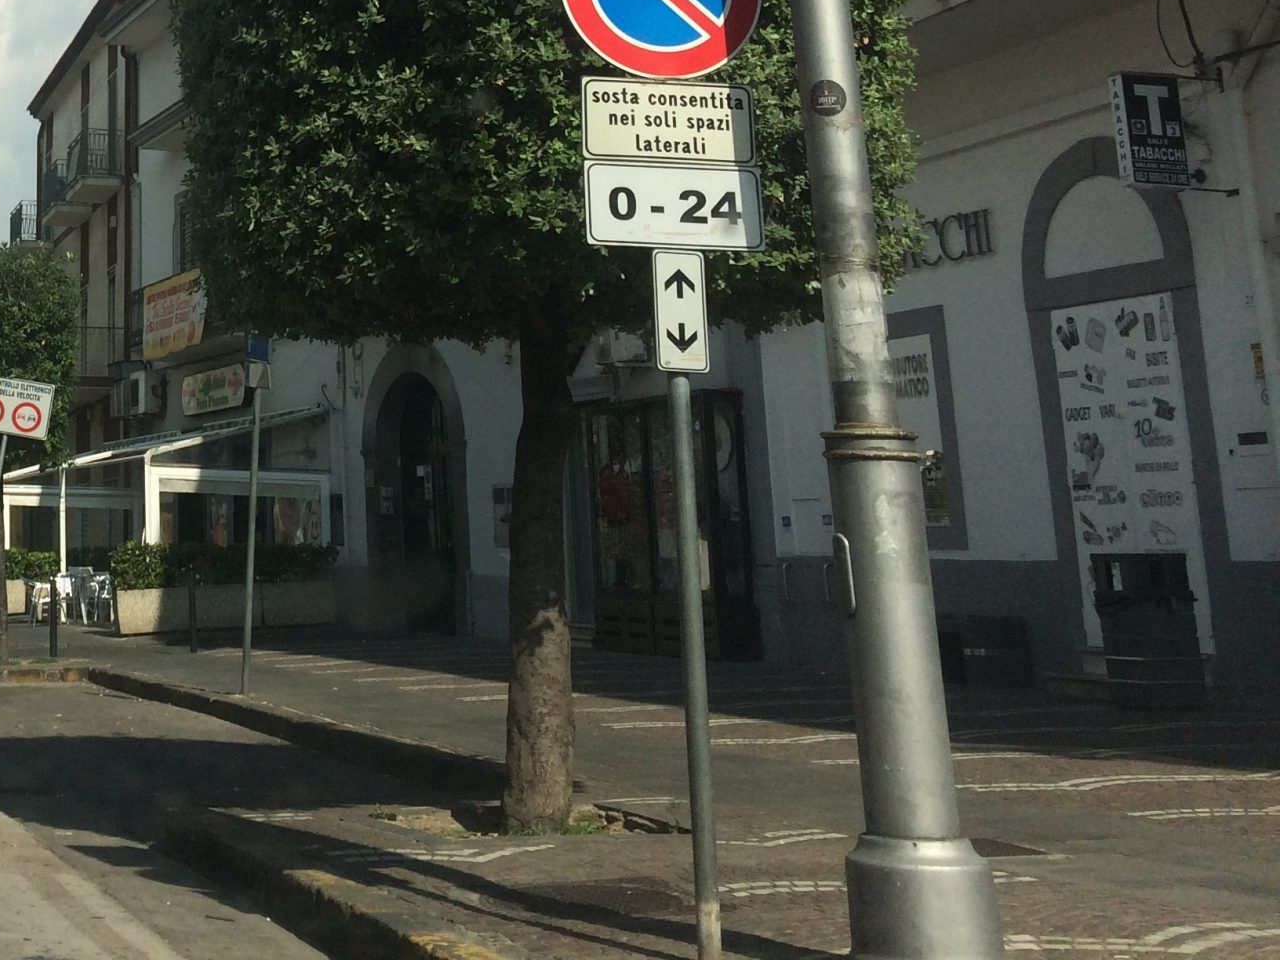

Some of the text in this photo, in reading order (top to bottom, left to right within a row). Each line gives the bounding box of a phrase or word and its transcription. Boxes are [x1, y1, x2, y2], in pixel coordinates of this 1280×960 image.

[592, 88, 744, 110] sosta consentita
[1133, 84, 1169, 136] T
[609, 110, 730, 132] nei soli spazi
[636, 134, 706, 155] laterali
[1131, 146, 1185, 161] TABACCHI
[609, 187, 636, 220] 0
[679, 190, 742, 226] 24
[0, 388, 15, 397] DELLA
[21, 383, 52, 395] ELETTRONICO
[1065, 406, 1091, 422] GADGET
[1135, 418, 1152, 438] 10
